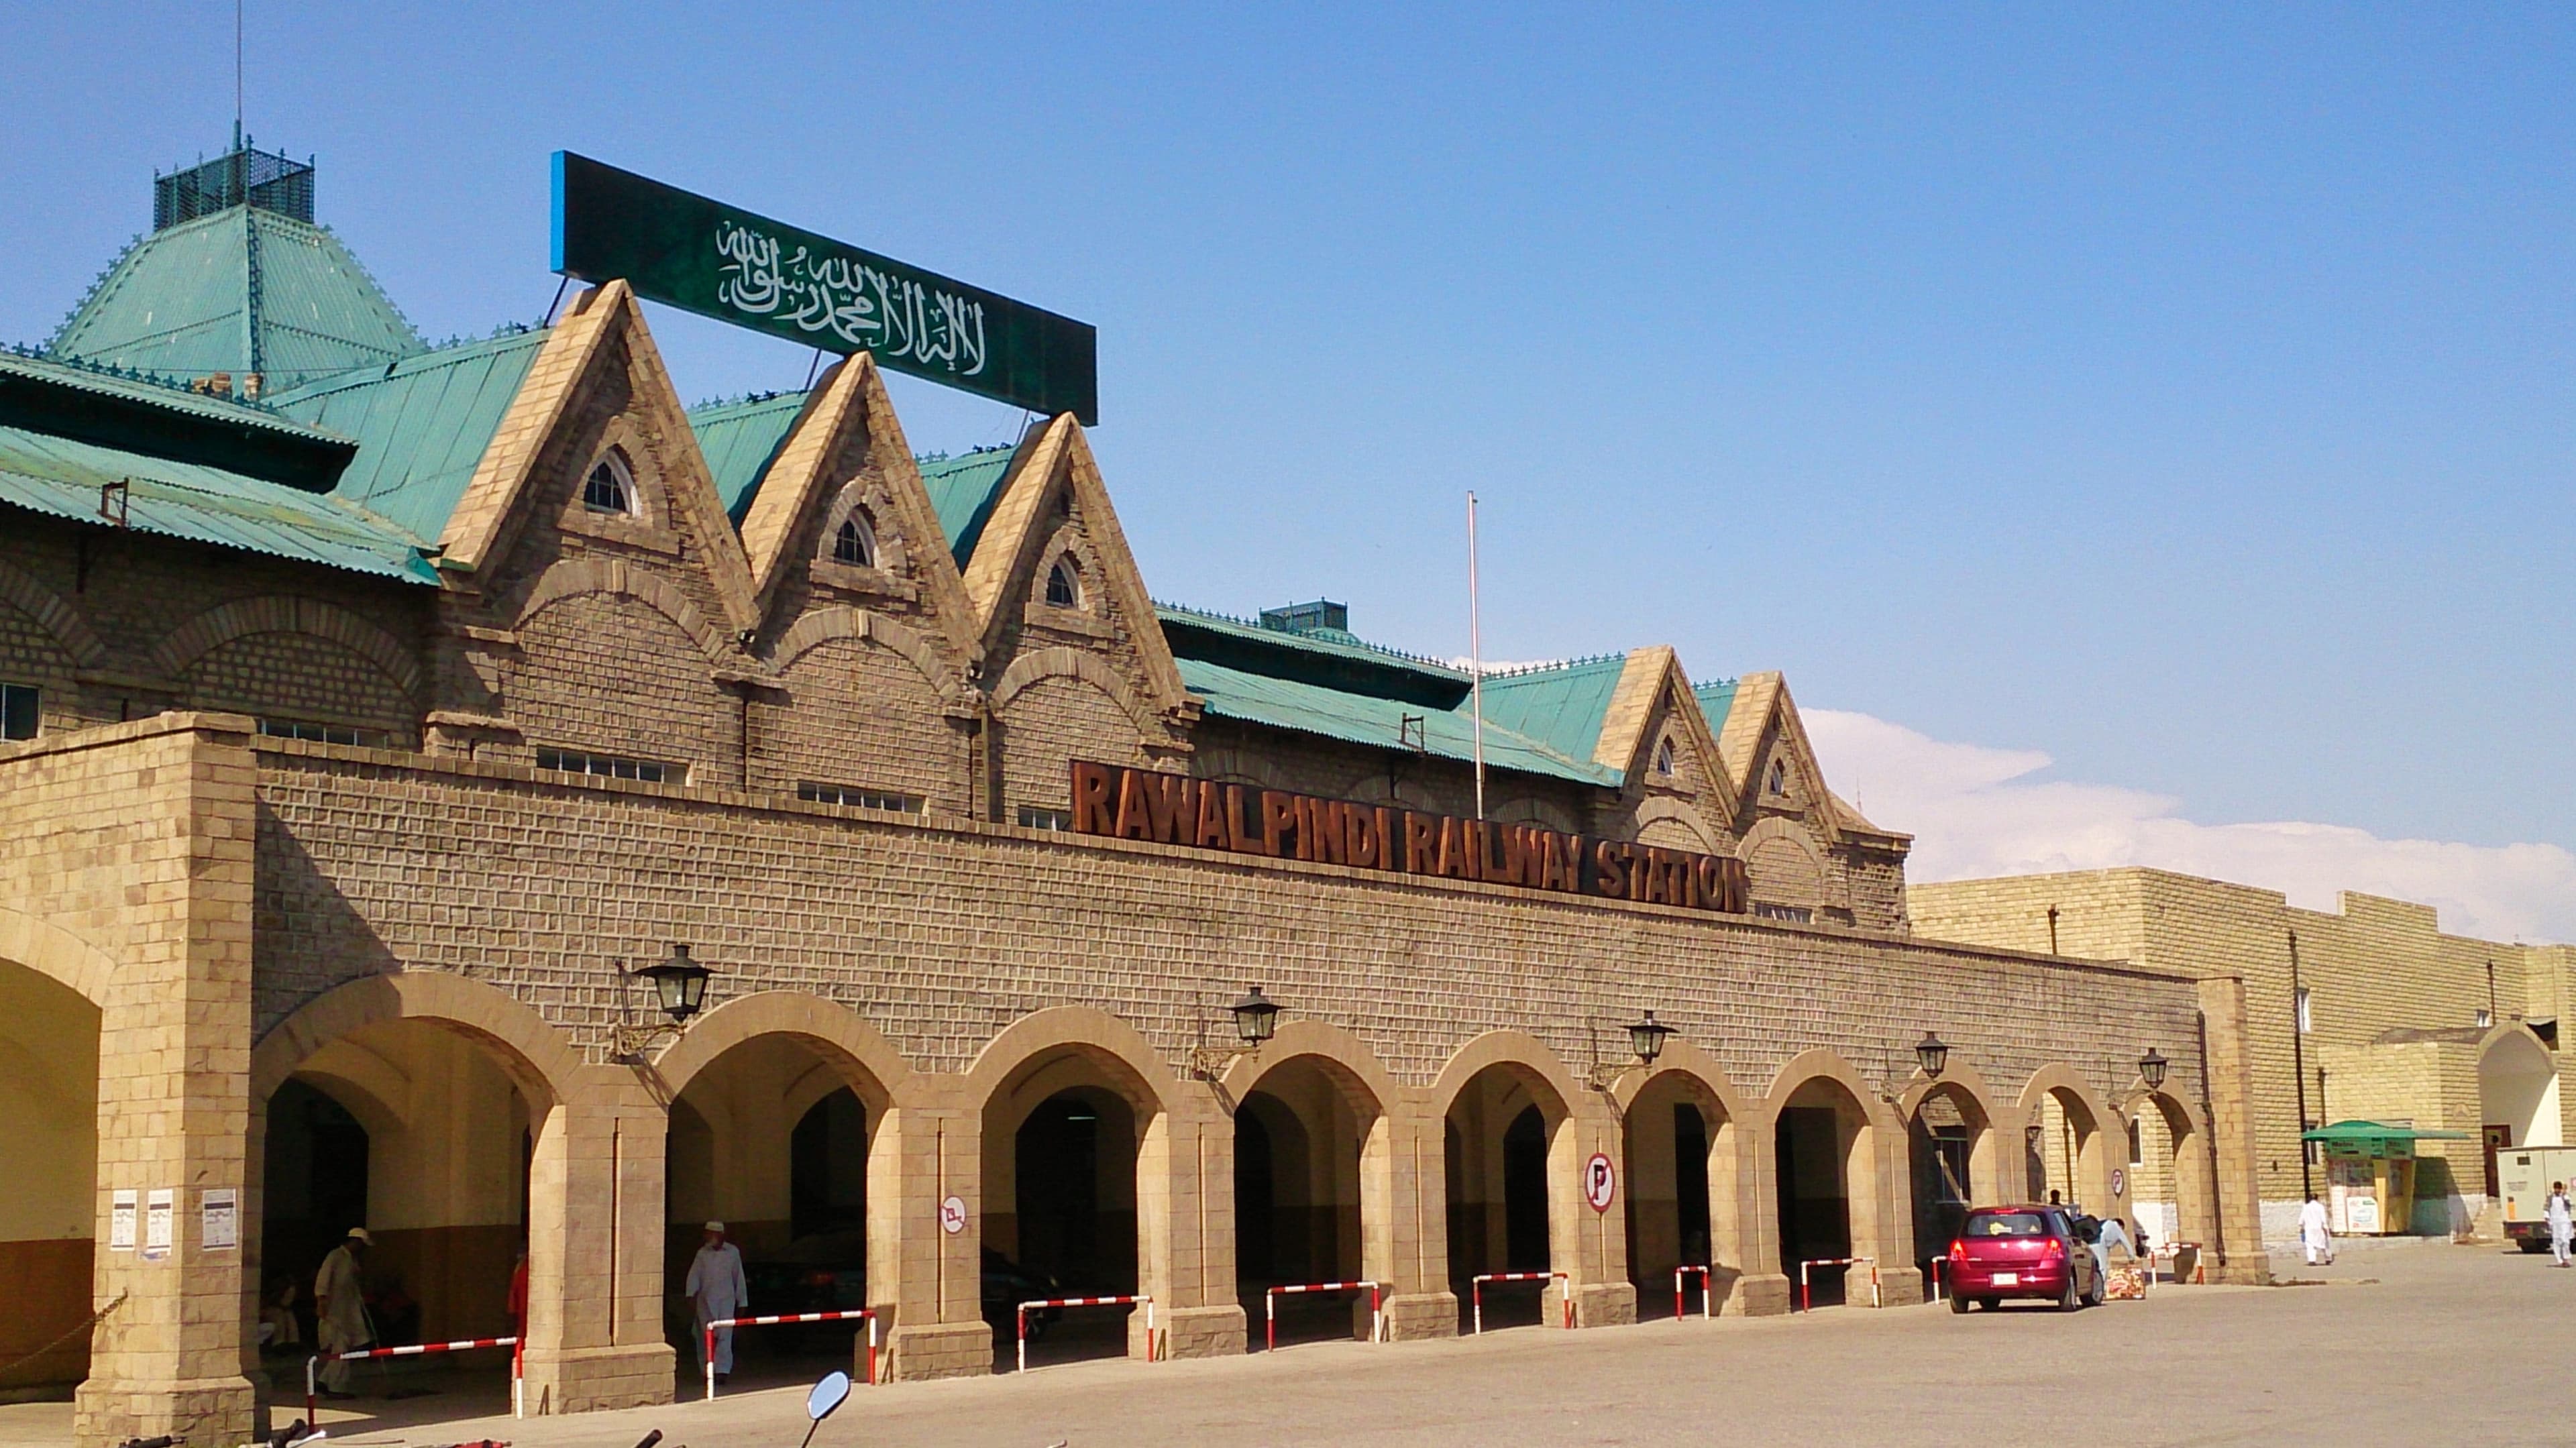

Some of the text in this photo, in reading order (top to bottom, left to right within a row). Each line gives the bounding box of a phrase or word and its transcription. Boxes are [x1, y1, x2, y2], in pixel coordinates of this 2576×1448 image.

[1073, 762, 1748, 913] RAWALPINDI RAILWAY STATION
